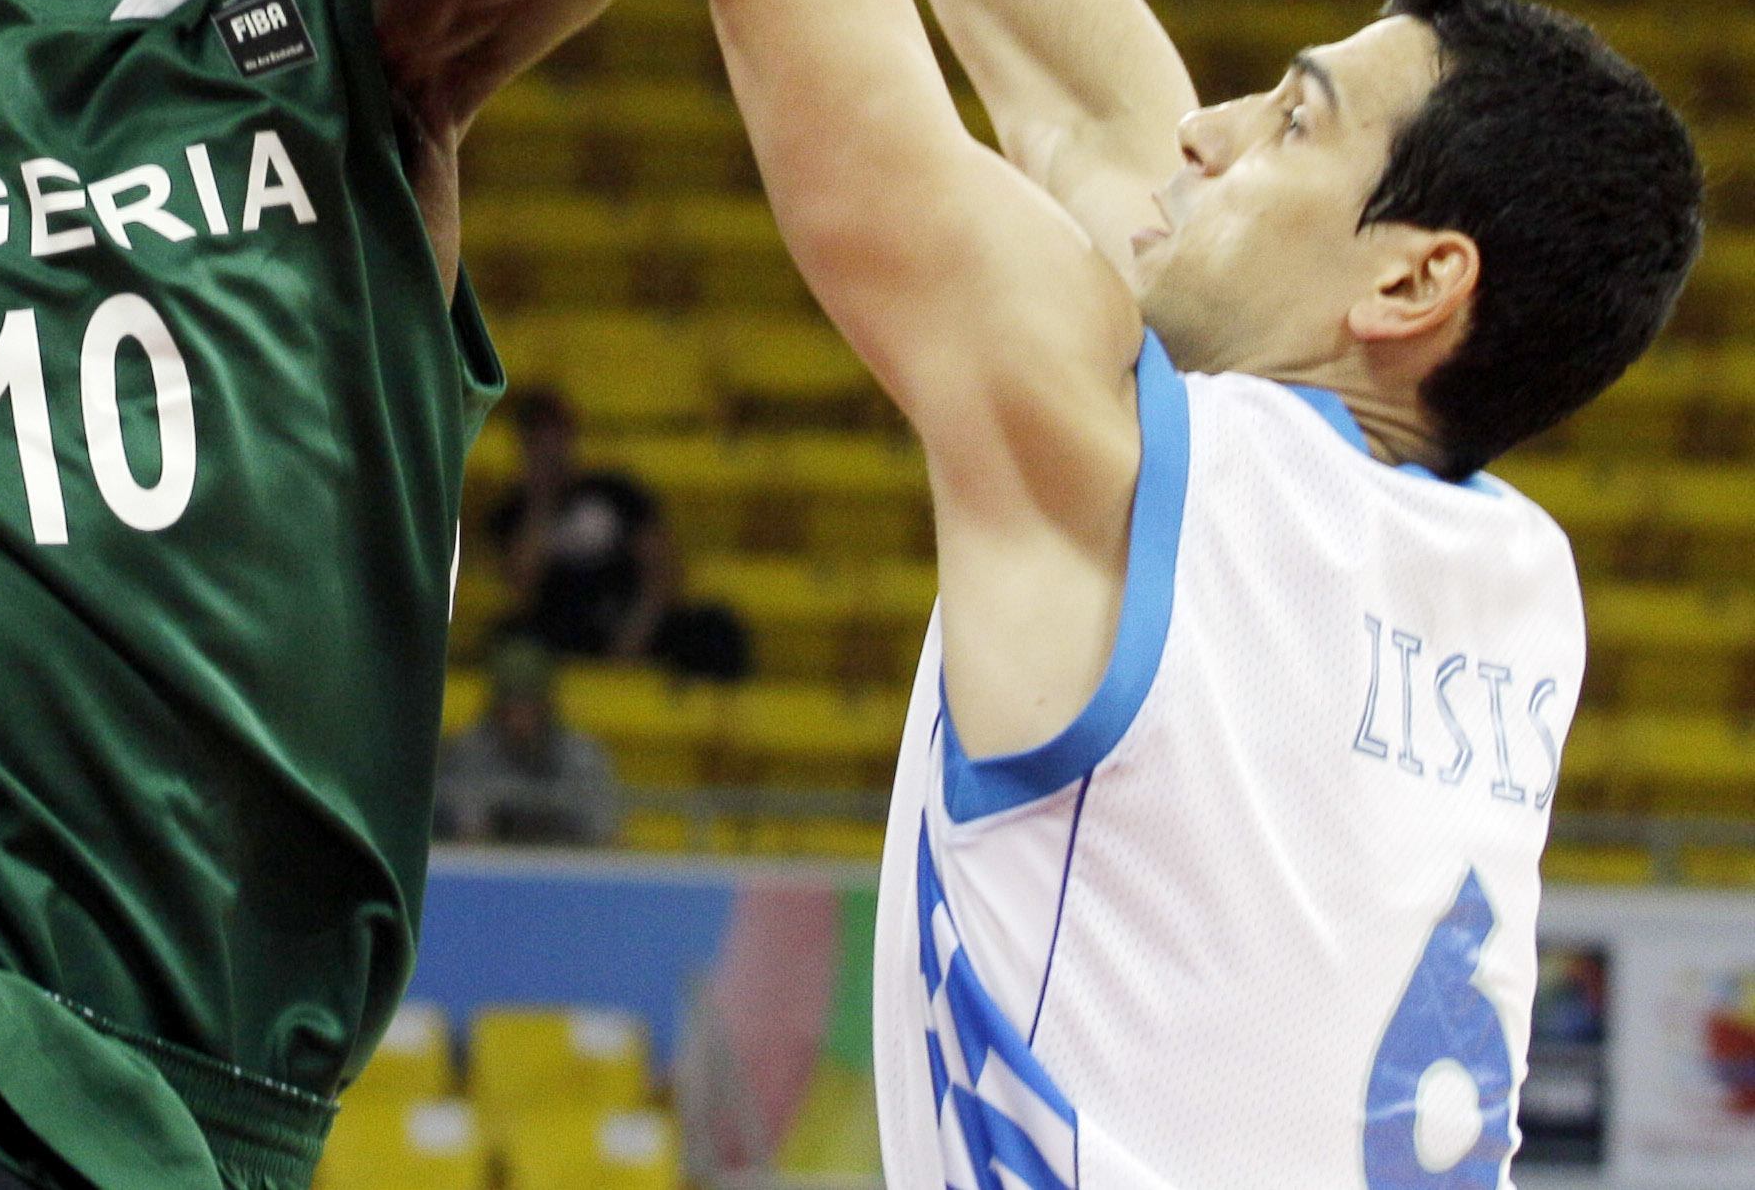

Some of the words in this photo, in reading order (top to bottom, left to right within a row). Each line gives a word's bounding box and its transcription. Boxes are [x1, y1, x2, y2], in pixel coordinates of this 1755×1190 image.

[230, 2, 288, 43] FIBA
[1353, 614, 1559, 810] LISIS
[1359, 864, 1514, 1190] 6
